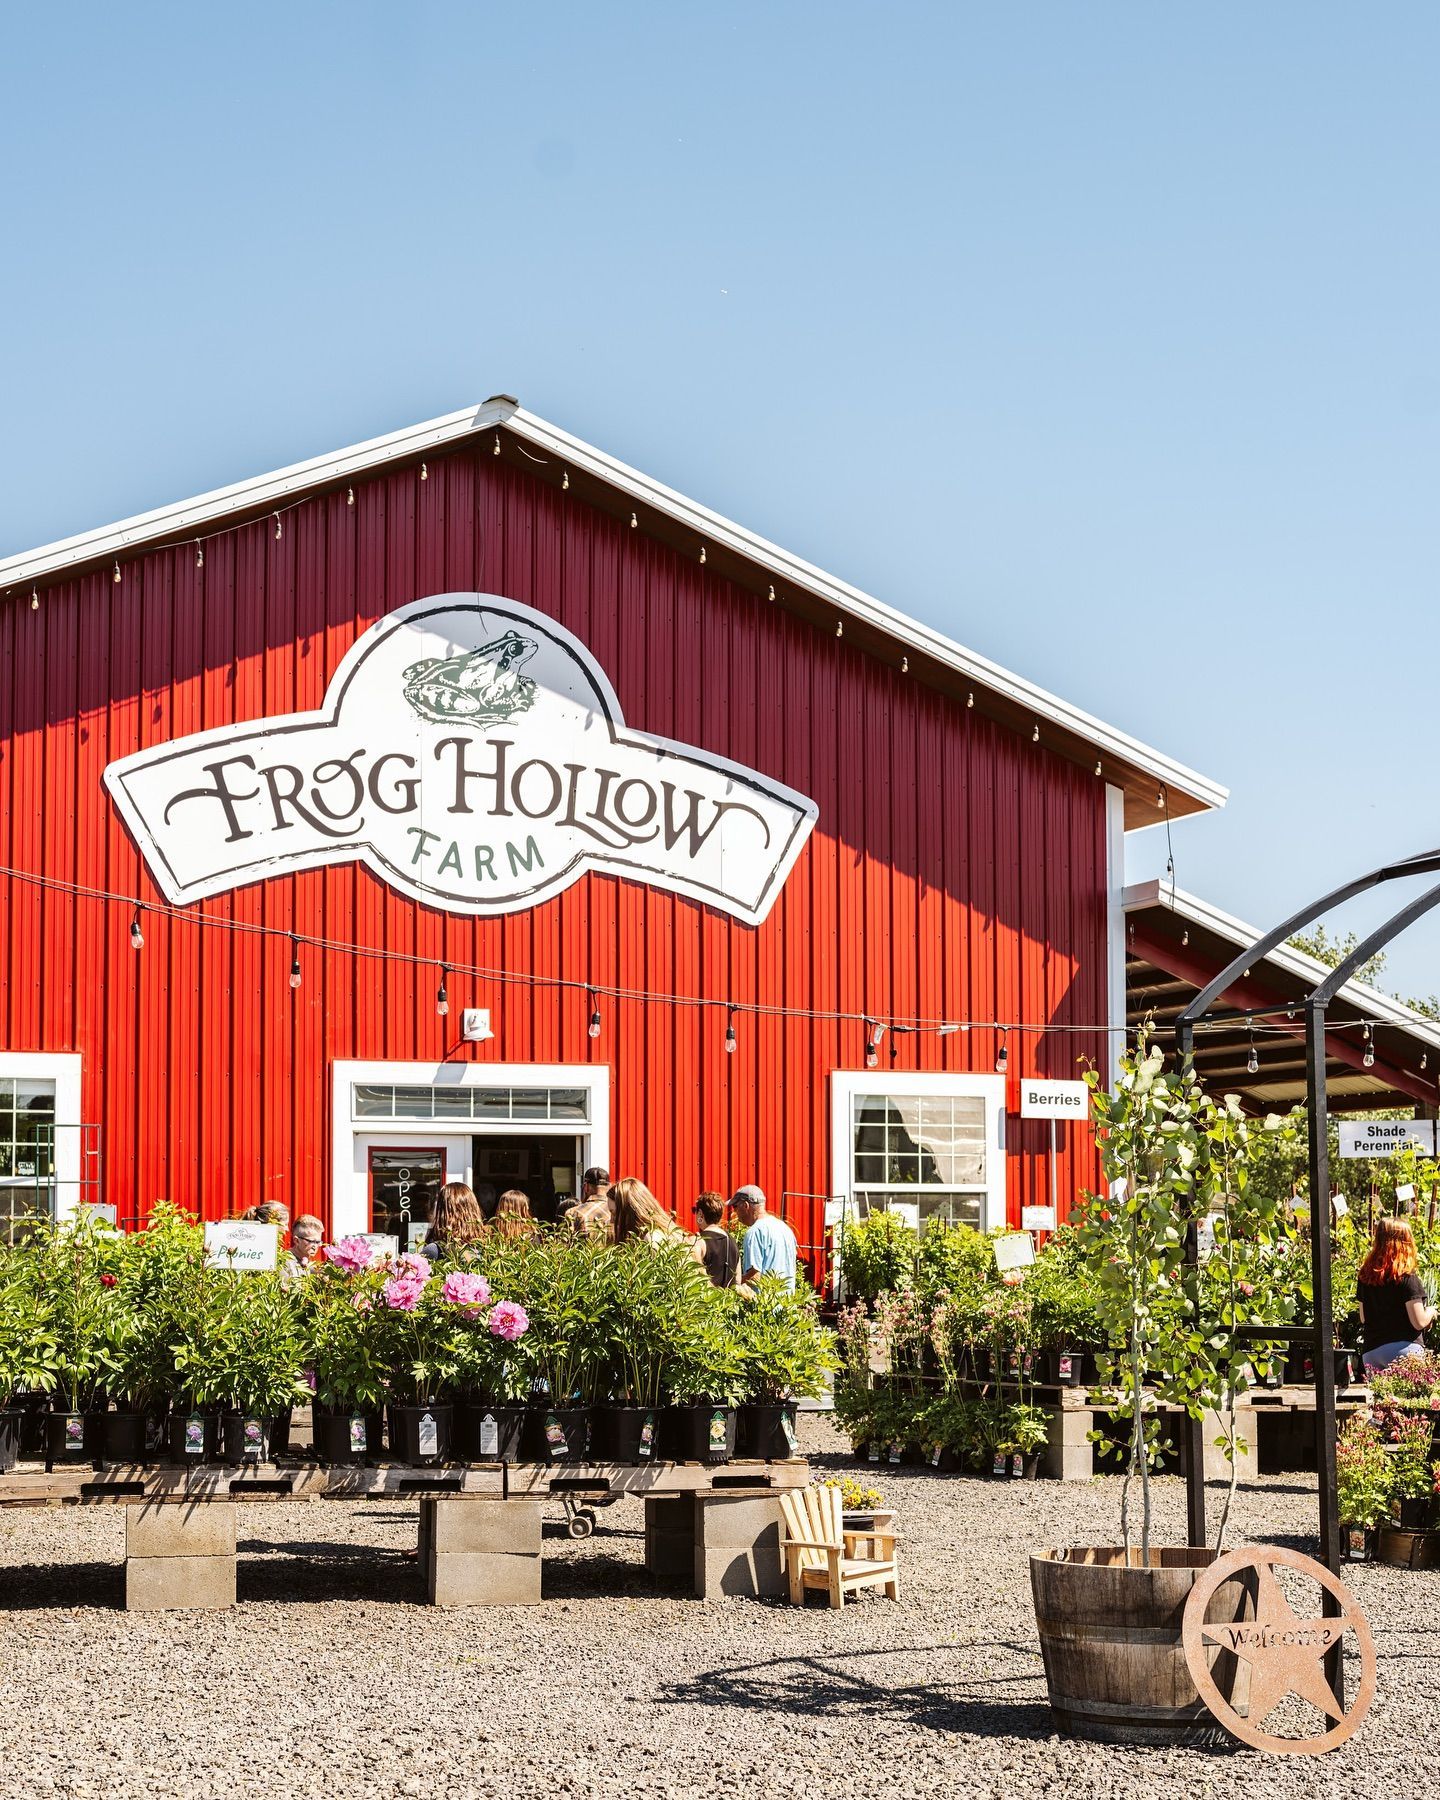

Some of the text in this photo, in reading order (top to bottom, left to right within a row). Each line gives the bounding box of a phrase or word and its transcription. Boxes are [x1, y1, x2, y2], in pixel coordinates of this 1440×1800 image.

[434, 737, 770, 858] HOLLOW
[407, 827, 545, 882] FARM
[1028, 1092, 1081, 1106] Berries
[1367, 1125, 1406, 1137] Shade
[1354, 1140, 1420, 1151] Perennial
[398, 1168, 411, 1222] open
[217, 1245, 264, 1260] Ponies
[1221, 1624, 1333, 1650] Welcome
